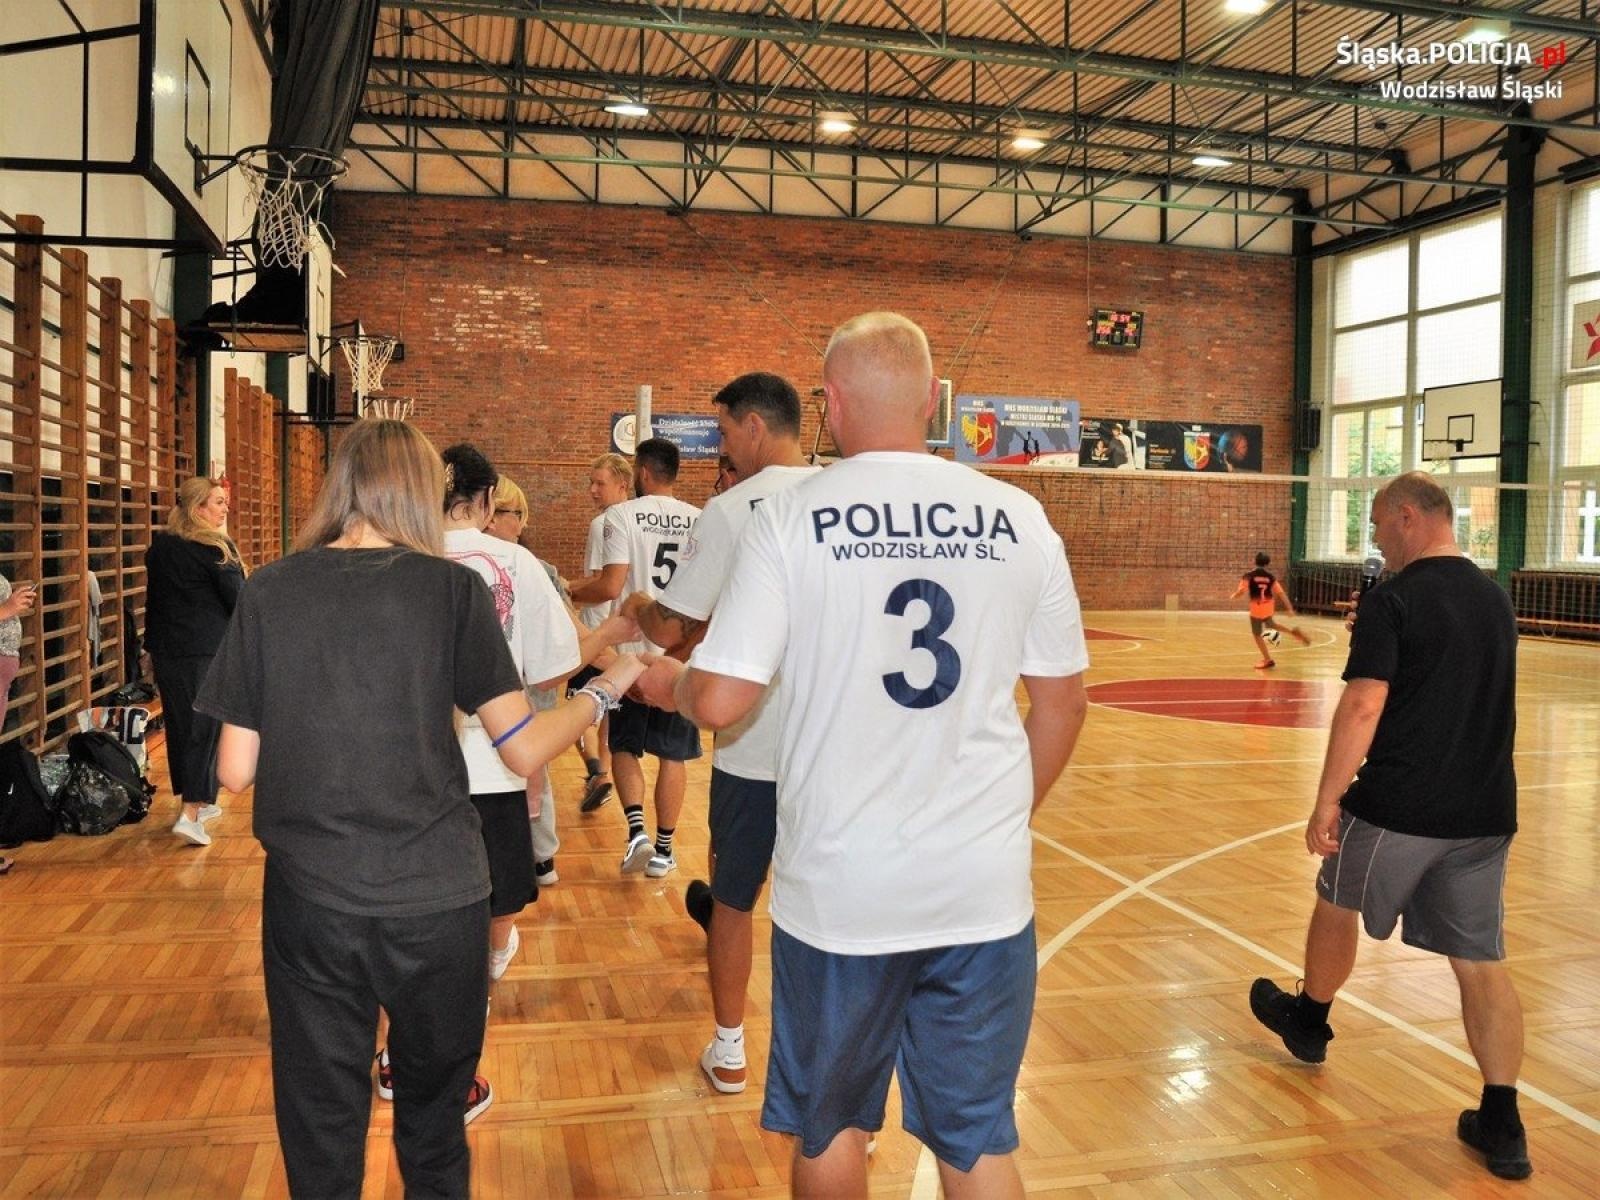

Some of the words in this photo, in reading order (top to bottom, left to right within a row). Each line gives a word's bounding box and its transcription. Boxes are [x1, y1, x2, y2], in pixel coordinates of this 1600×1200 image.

[811, 503, 1018, 544] POLICJA
[652, 543, 679, 590] 5
[832, 542, 967, 561] WODZISŁAW
[975, 540, 1006, 562] ŚL.
[1258, 584, 1268, 600] 7
[882, 578, 961, 709] 3
